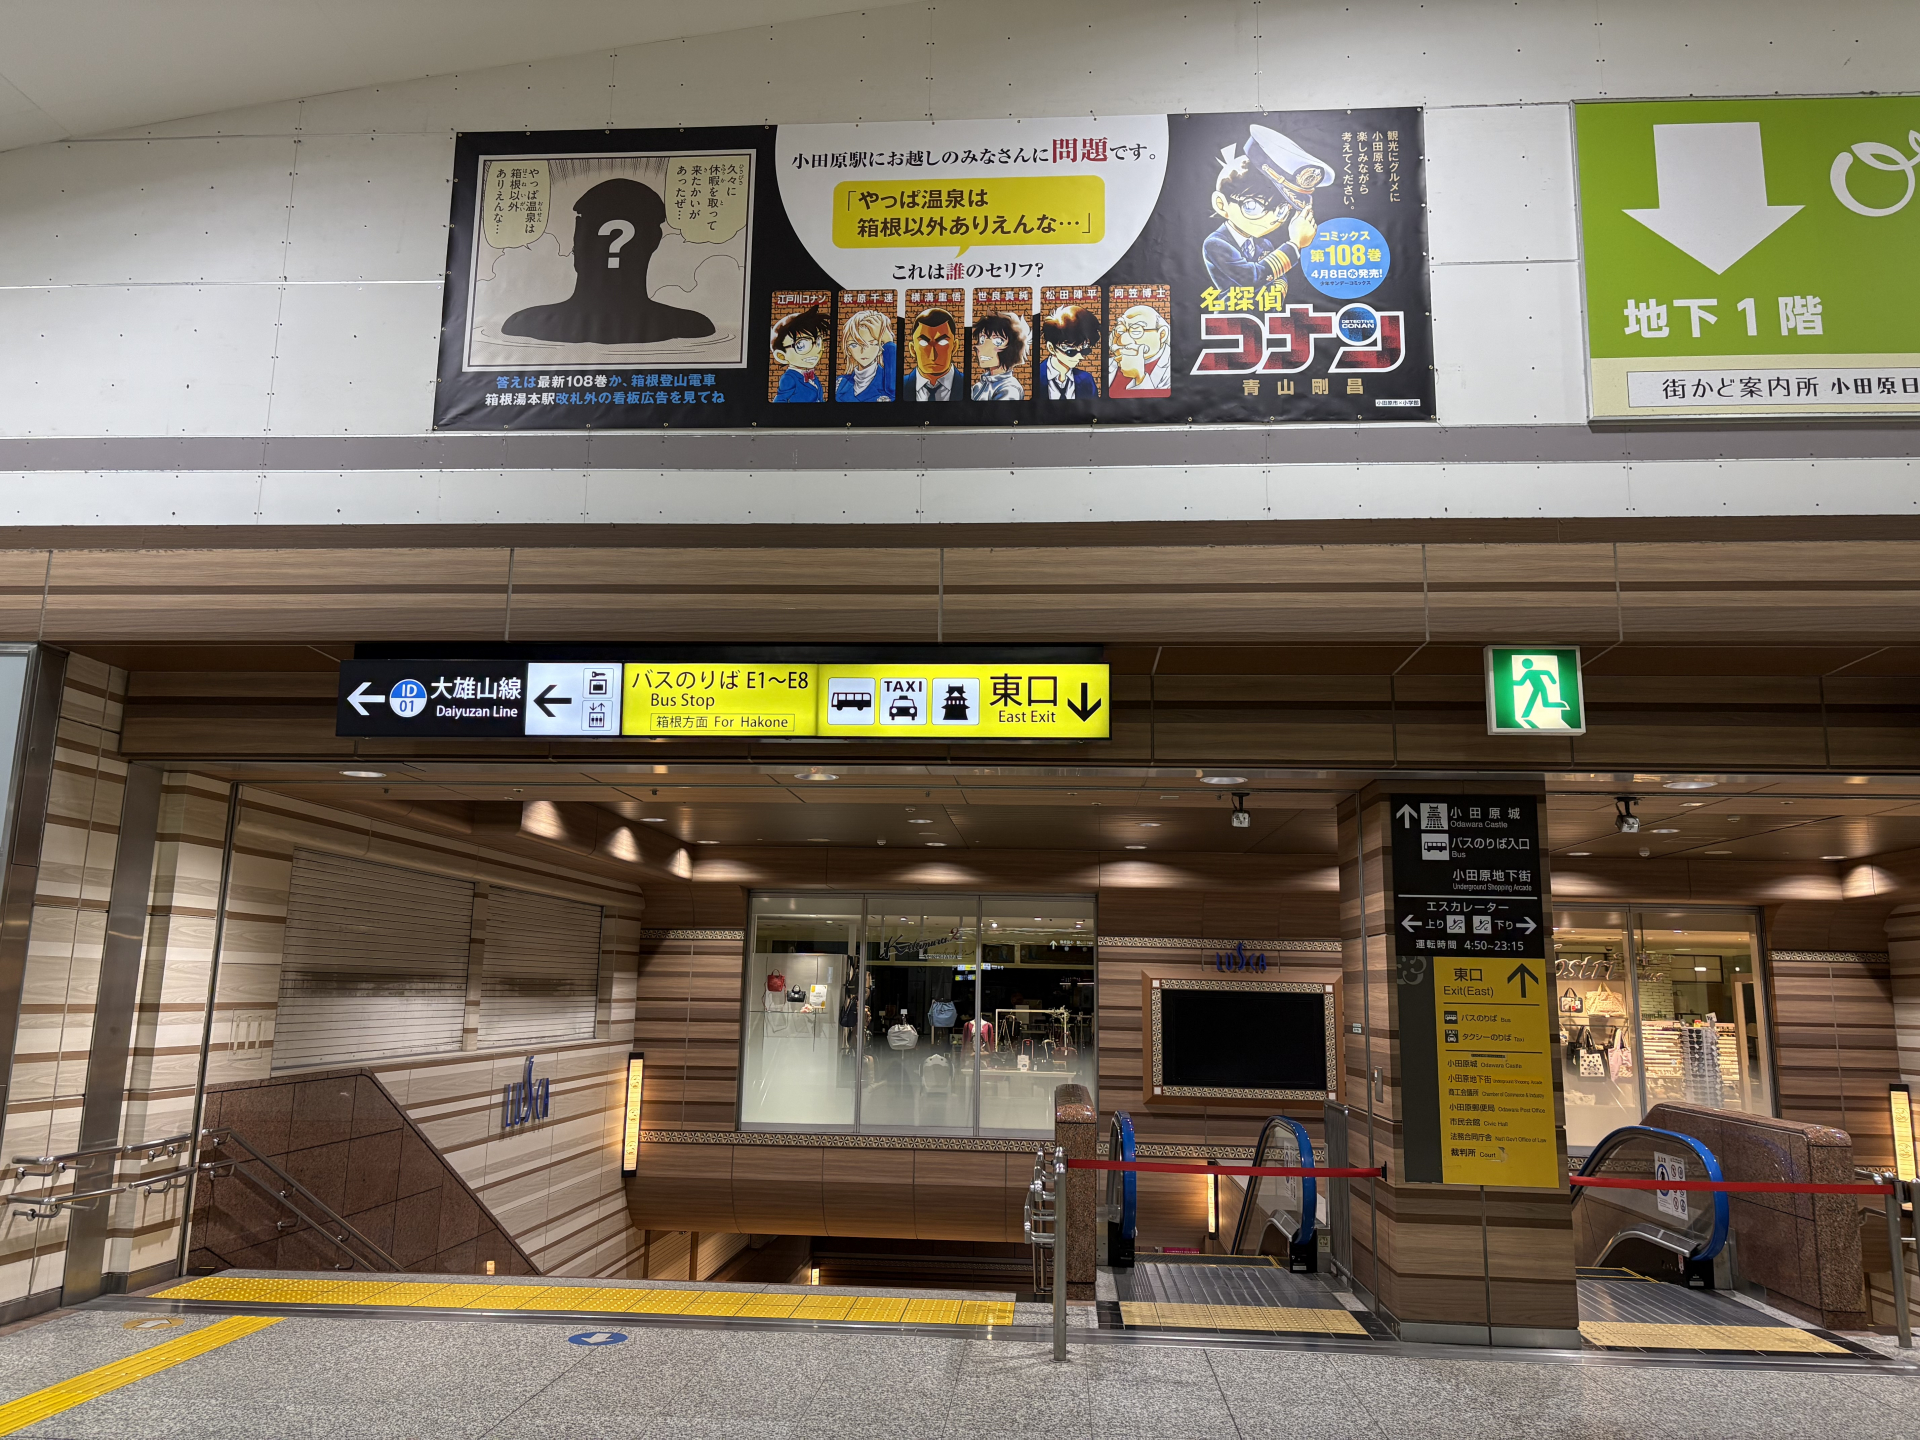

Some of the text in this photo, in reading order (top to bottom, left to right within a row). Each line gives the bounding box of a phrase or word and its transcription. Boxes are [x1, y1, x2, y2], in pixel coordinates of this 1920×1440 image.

[791, 136, 1157, 170] 小田原駅にお越しのみなさんに問題です。
[1372, 131, 1384, 173] 小田原を
[1356, 131, 1369, 195] 楽しみながら
[1386, 130, 1401, 203] 観光にグルメに
[1341, 131, 1355, 210] 考えてください。
[726, 164, 738, 196] 久々に
[508, 168, 522, 212] 箱根以外
[689, 165, 703, 220] 来たかいが
[525, 168, 540, 234] やっぱ温泉は
[707, 164, 721, 231] 休暇を取って
[847, 188, 989, 211] 「やっぱ温泉は
[1320, 231, 1371, 241] コミックス
[598, 219, 635, 268] ?
[1310, 244, 1382, 266] 第108巻
[892, 262, 1044, 281] これは誰のセリフ?
[777, 294, 827, 305] 江戸川コナン
[843, 292, 894, 304] 萩原千速
[978, 289, 1029, 301] 世良真純
[1045, 288, 1098, 300] 松田陣平
[1114, 287, 1167, 299] 阿笠博士
[1200, 286, 1282, 312] 名探偵
[1624, 295, 1824, 338] 地下1階
[1190, 303, 1405, 374] コナン
[495, 374, 716, 389] 答えは最新108巻か、箱根登山電車
[1242, 378, 1364, 396] 青山剛昌
[1662, 376, 1819, 399] 街かど案内所
[484, 391, 726, 406] 箱根湯本駅改札外の看板広告を見てね
[631, 670, 739, 690] バスのりば
[884, 681, 923, 692] TAXI
[401, 683, 417, 697] ID
[430, 676, 521, 700] 大雄山線
[989, 674, 1058, 707] 東口
[399, 699, 415, 713] 01
[651, 693, 715, 709] Bus Stop
[436, 705, 518, 718] Daiyuzan Line
[998, 710, 1056, 723] East Exit
[655, 716, 788, 729] 箱根方面 For Hakone
[1450, 807, 1521, 819] 小田原城
[1451, 838, 1530, 850] バスのりば入口
[1452, 869, 1531, 882] 小田原地下街
[1452, 883, 1487, 891] Underground
[1487, 884, 1513, 892] Shopping
[1426, 902, 1509, 912] エスカレーター
[1425, 920, 1444, 929] 上り
[1494, 920, 1513, 930] 下り
[1416, 940, 1524, 951] 運転時間 4:50~23:15
[1216, 941, 1267, 971] LUSCA
[1453, 968, 1483, 982] 東口
[1443, 986, 1494, 998] Exit(East)
[1461, 1014, 1498, 1022] バスのりば
[1462, 1033, 1512, 1042] タクシーのりば
[1447, 1060, 1478, 1068] 小田原城
[1448, 1074, 1492, 1084] 小田原地下街
[506, 1055, 549, 1127] LUSCA
[1450, 1118, 1481, 1126] 市民会館
[1450, 1148, 1476, 1157] 裁判所
